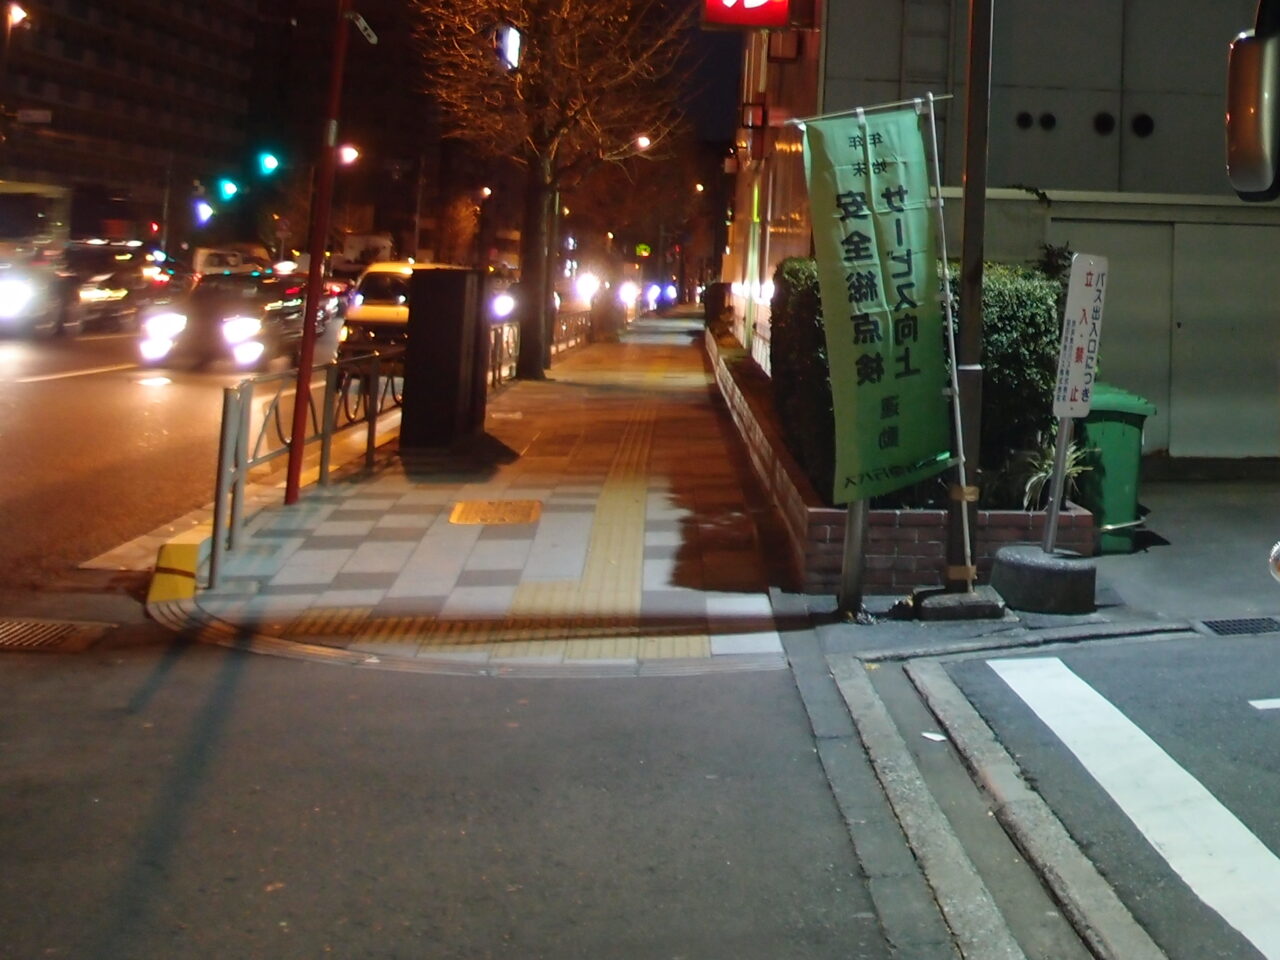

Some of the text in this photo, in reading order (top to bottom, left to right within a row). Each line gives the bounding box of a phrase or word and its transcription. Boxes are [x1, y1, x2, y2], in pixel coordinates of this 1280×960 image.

[1069, 271, 1094, 402] 立入禁止
[1081, 273, 1106, 403] バス出入口につき
